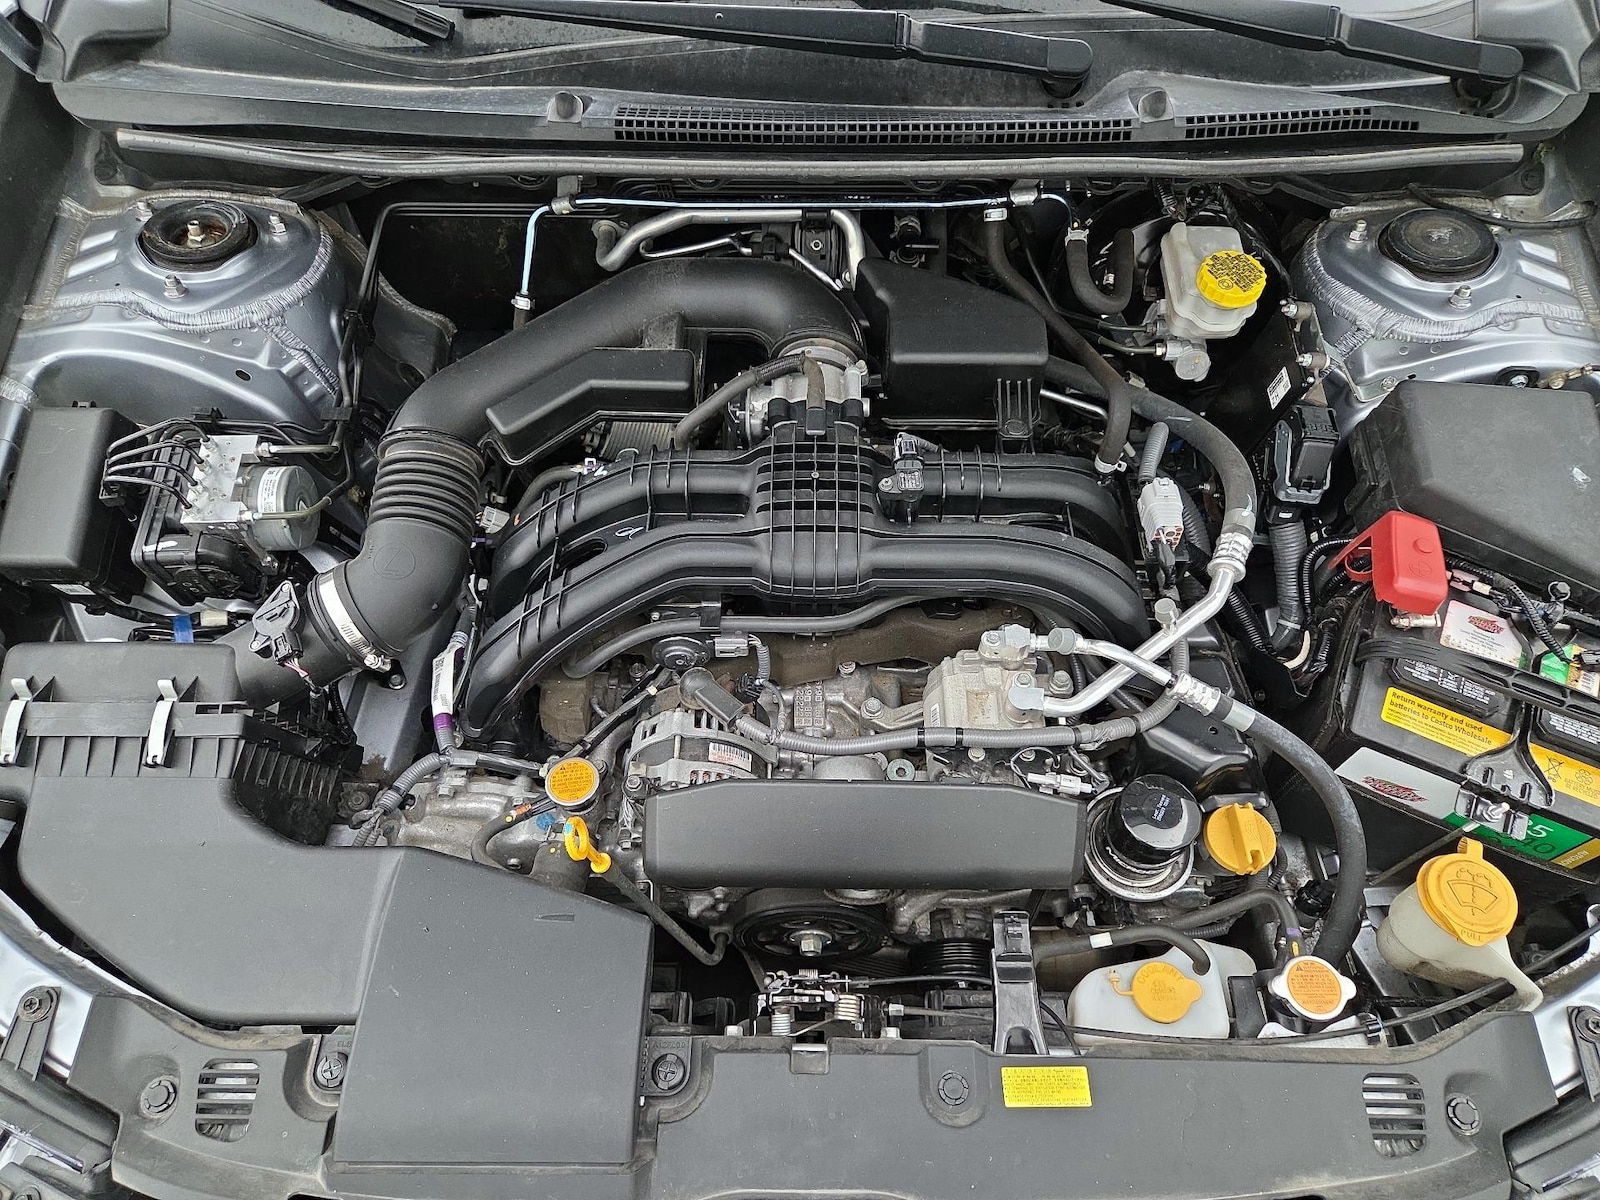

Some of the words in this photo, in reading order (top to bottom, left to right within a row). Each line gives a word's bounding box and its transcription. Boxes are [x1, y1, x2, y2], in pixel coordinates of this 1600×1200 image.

[1389, 699, 1420, 717] batteries
[1421, 712, 1429, 720] to
[1429, 715, 1453, 730] Costco
[1454, 725, 1492, 745] Wholesale
[1391, 691, 1416, 706] Return
[1415, 701, 1448, 720] warranty
[1449, 714, 1463, 725] and
[1464, 720, 1482, 732] used
[1136, 964, 1184, 984] COOLANT
